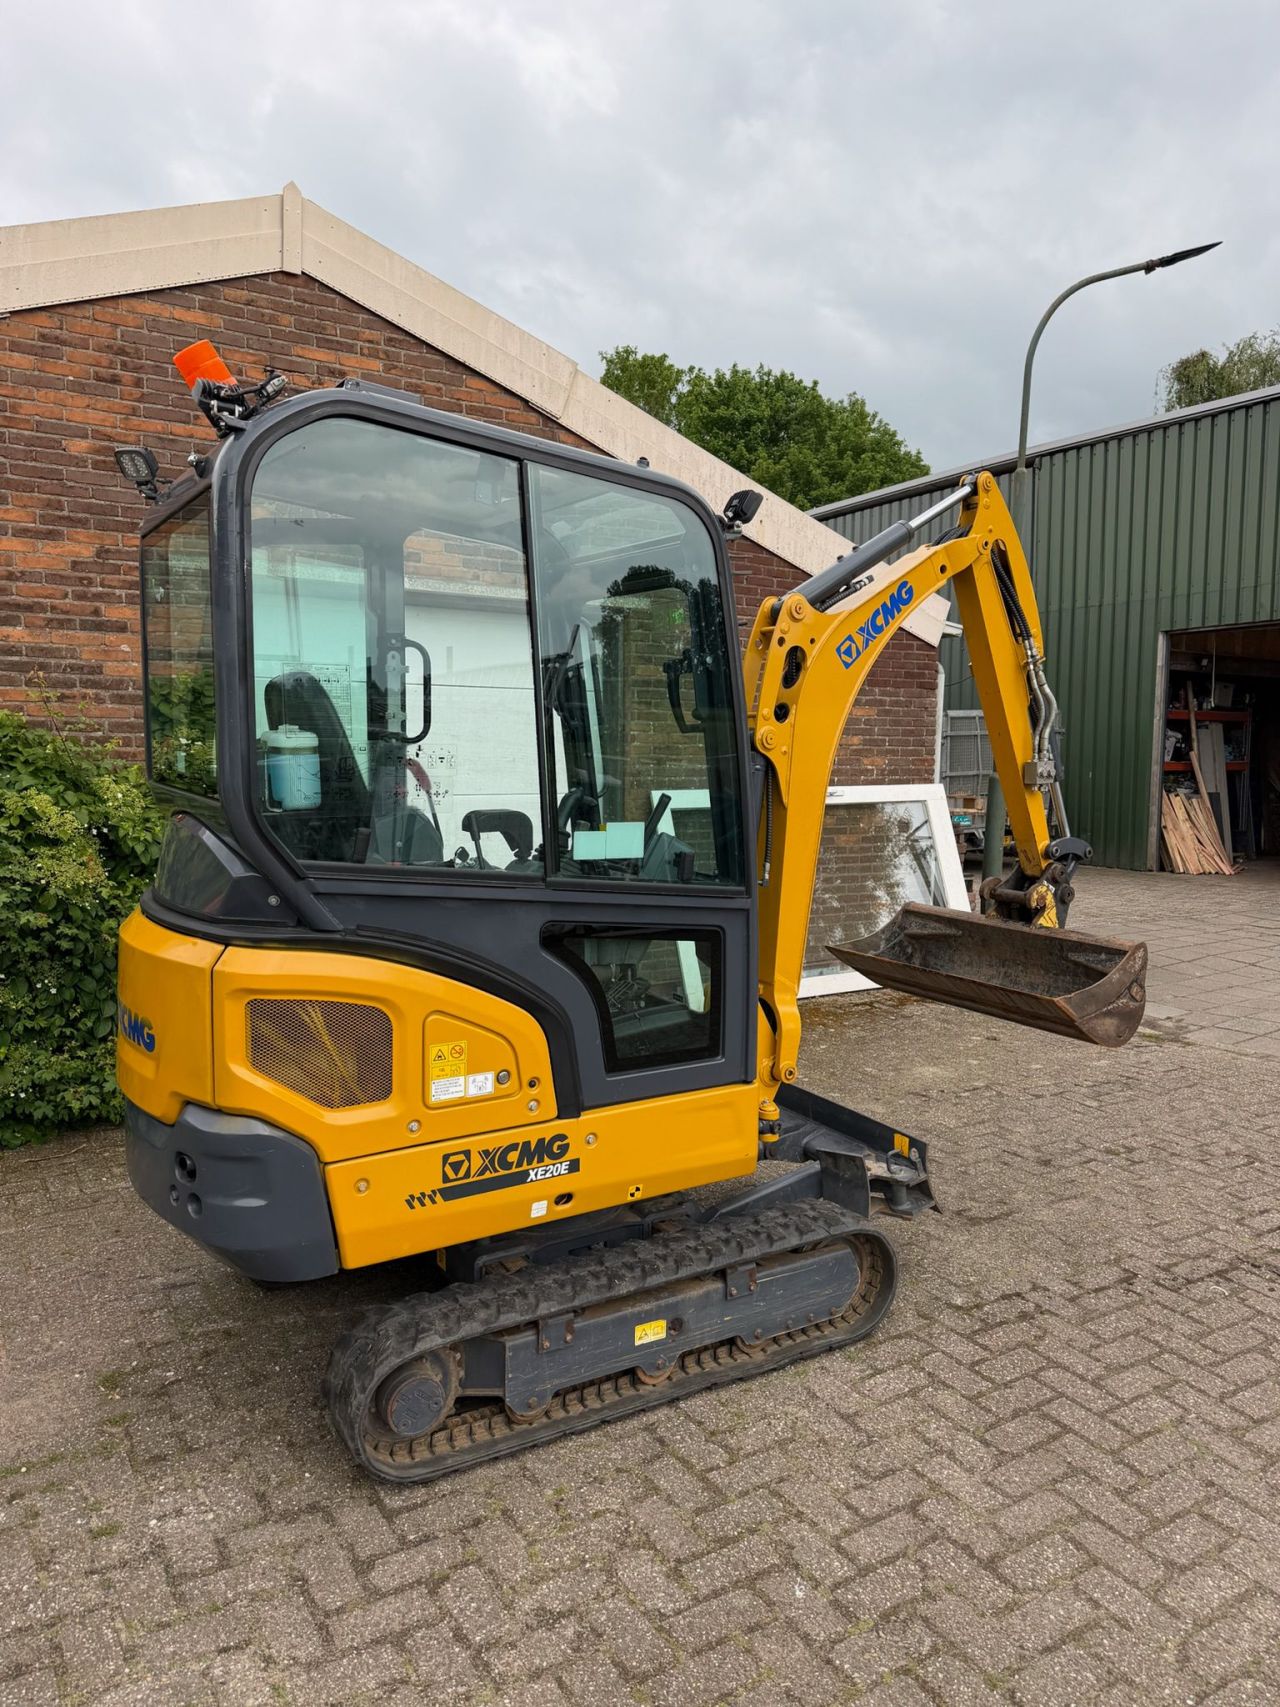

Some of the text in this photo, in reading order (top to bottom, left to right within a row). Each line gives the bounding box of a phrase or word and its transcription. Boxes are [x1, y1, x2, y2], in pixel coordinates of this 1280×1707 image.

[856, 580, 914, 654] XCMG
[119, 1000, 156, 1053] CMG
[471, 1133, 570, 1178] XCMG
[526, 1161, 570, 1183] XE20E
